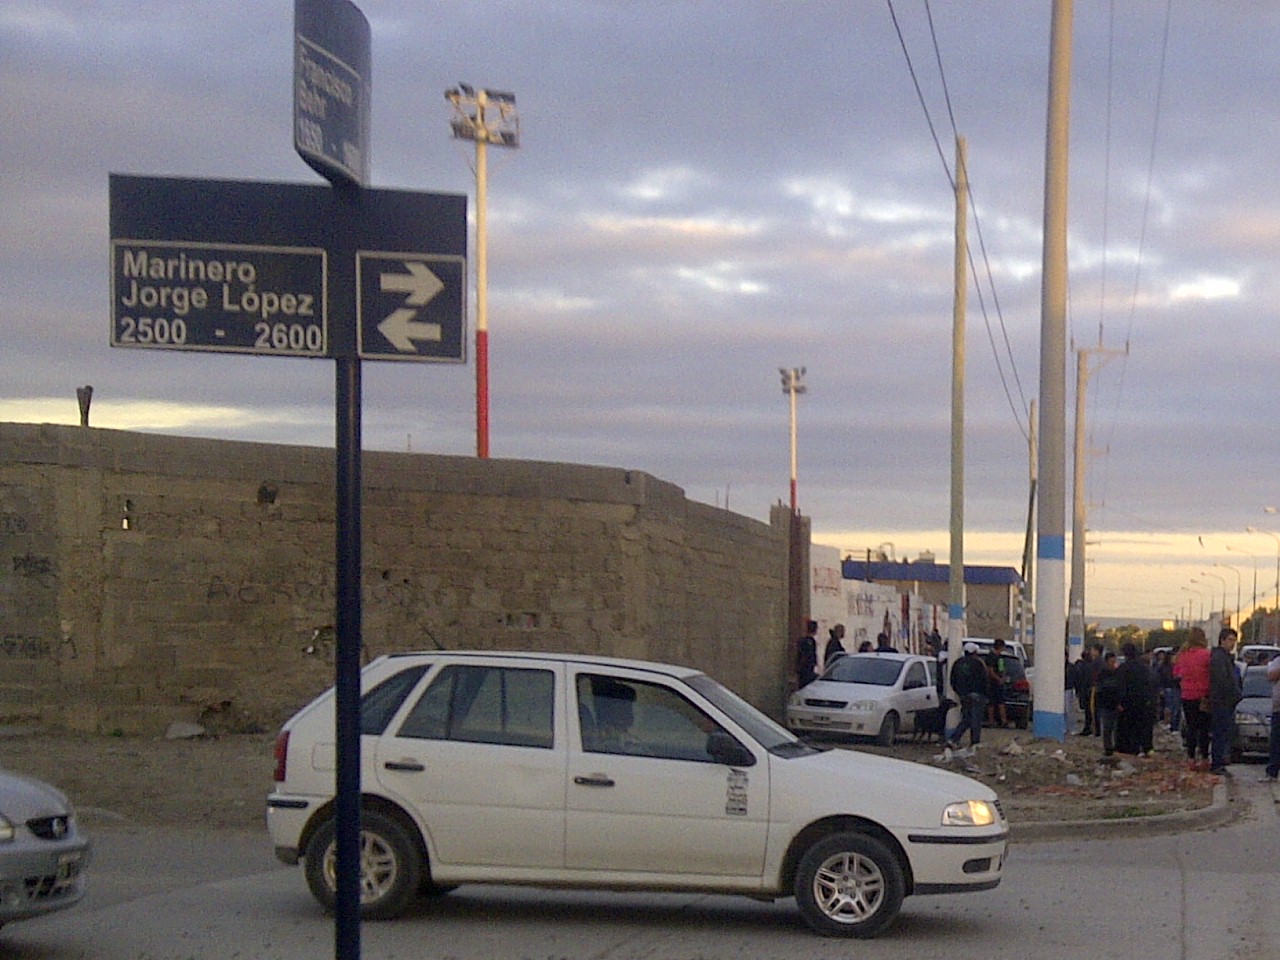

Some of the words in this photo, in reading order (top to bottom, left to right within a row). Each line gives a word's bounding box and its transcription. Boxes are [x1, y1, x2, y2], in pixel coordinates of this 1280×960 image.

[123, 250, 256, 283] Marinero
[121, 280, 208, 315] Jorge
[223, 282, 314, 319] López
[120, 316, 187, 344] 2500
[214, 328, 226, 337] -
[254, 322, 322, 350] 2600
